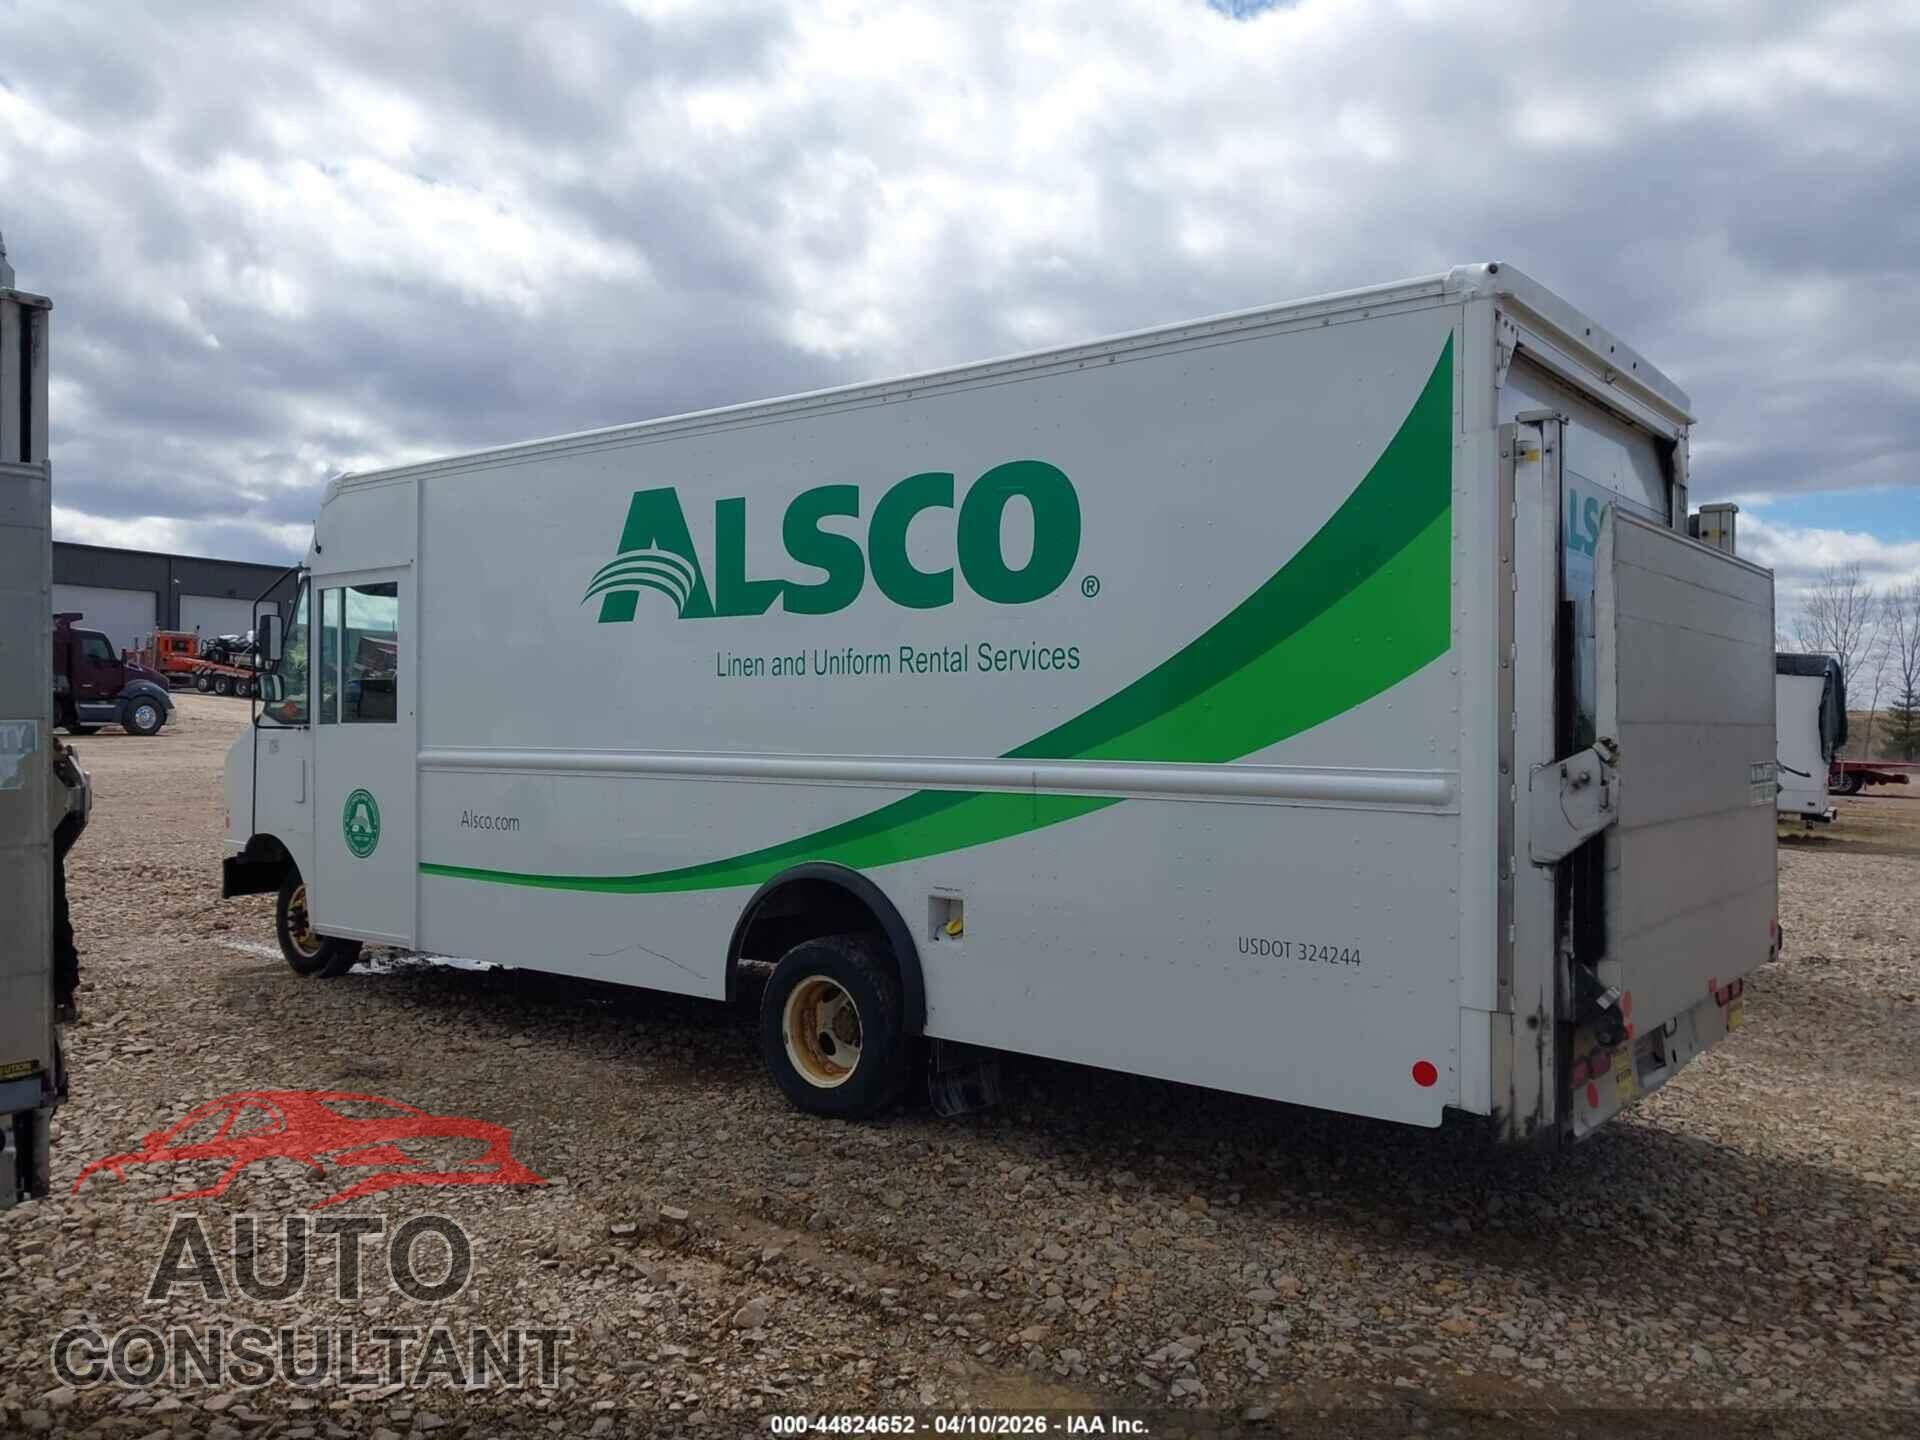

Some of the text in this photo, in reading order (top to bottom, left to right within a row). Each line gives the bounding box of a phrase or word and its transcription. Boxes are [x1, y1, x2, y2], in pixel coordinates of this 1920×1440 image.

[588, 459, 1081, 623] ALSCO
[1567, 488, 1602, 557] LS
[716, 641, 1081, 678] Linen and Uniform Rental Services
[460, 809, 520, 832] Alsco.com
[1238, 935, 1361, 967] USDOT 324244
